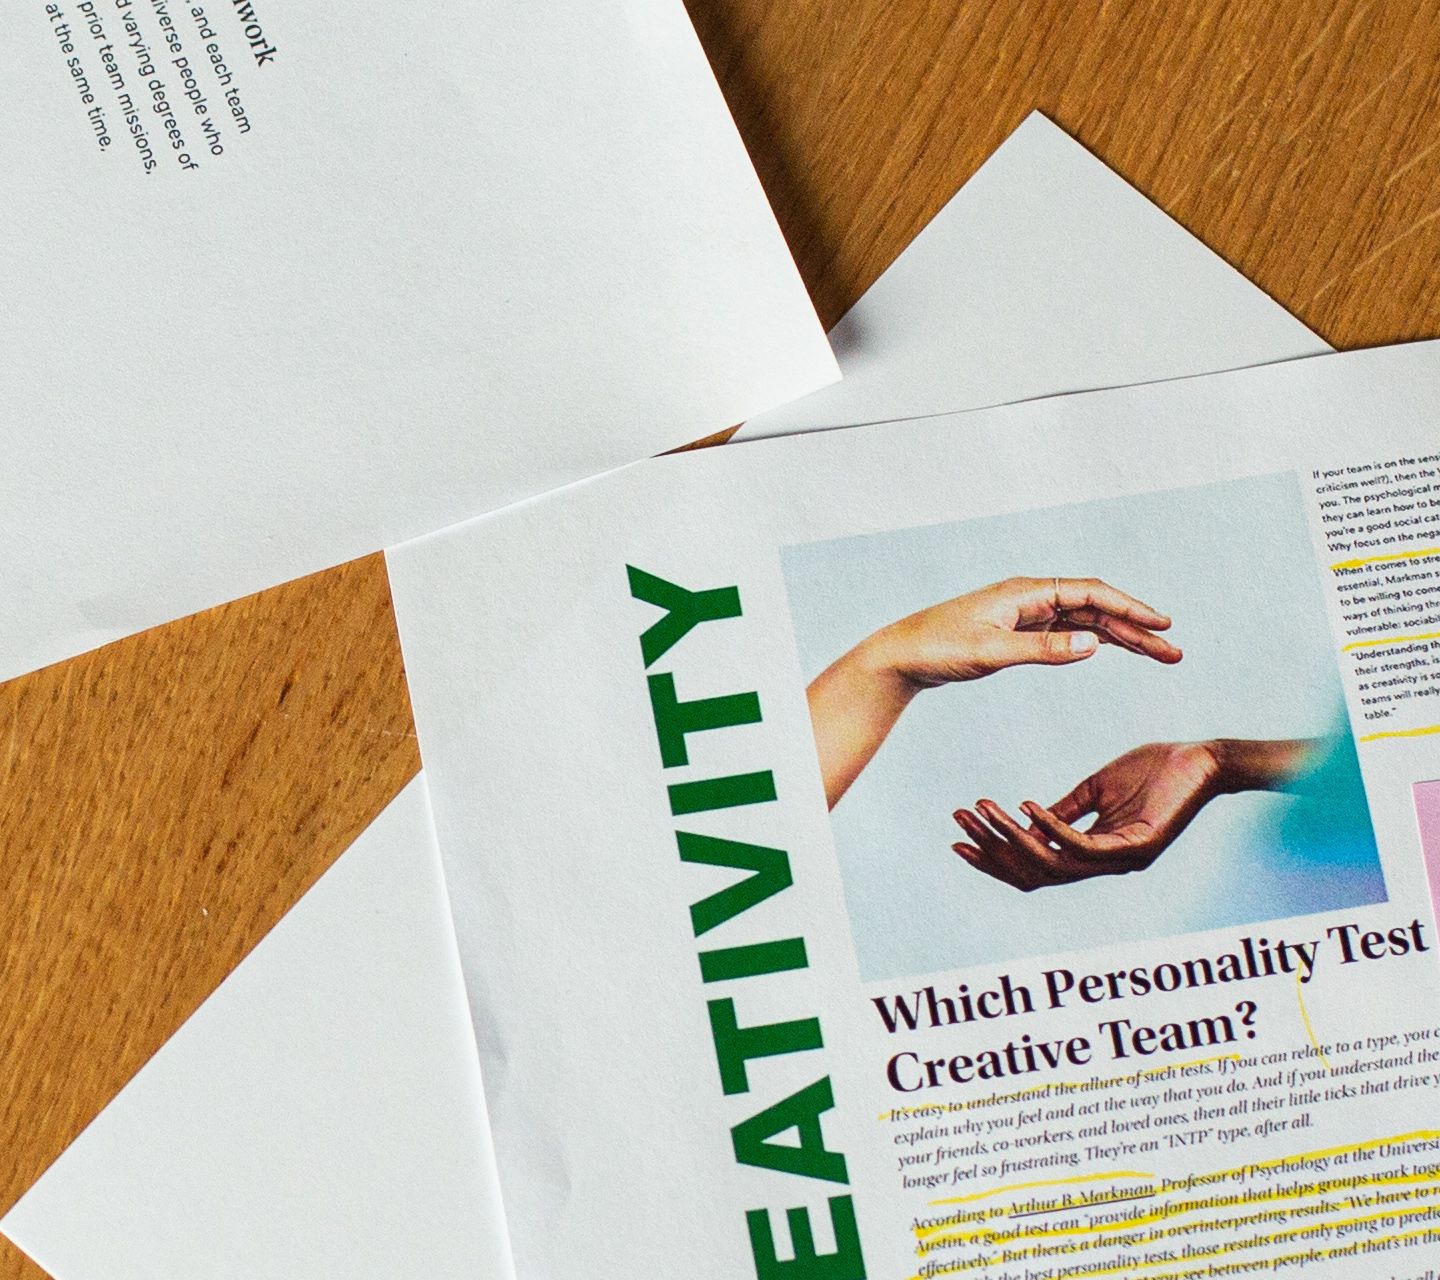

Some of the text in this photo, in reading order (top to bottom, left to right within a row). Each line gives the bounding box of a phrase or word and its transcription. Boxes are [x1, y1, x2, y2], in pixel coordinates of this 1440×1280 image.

[189, 6, 217, 40] and
[204, 42, 233, 87] each
[223, 86, 251, 134] team
[870, 918, 1430, 1034] Which Personality Test
[885, 999, 1257, 1093] Creative Team?
[901, 1171, 949, 1189] longer
[950, 1162, 978, 1186] feel
[980, 1164, 998, 1177] so
[998, 1151, 1081, 1178] frustrating.
[1138, 1139, 1159, 1153] an
[1216, 1125, 1251, 1145] type,
[1253, 1117, 1289, 1138] after
[1290, 1111, 1313, 1130] all.
